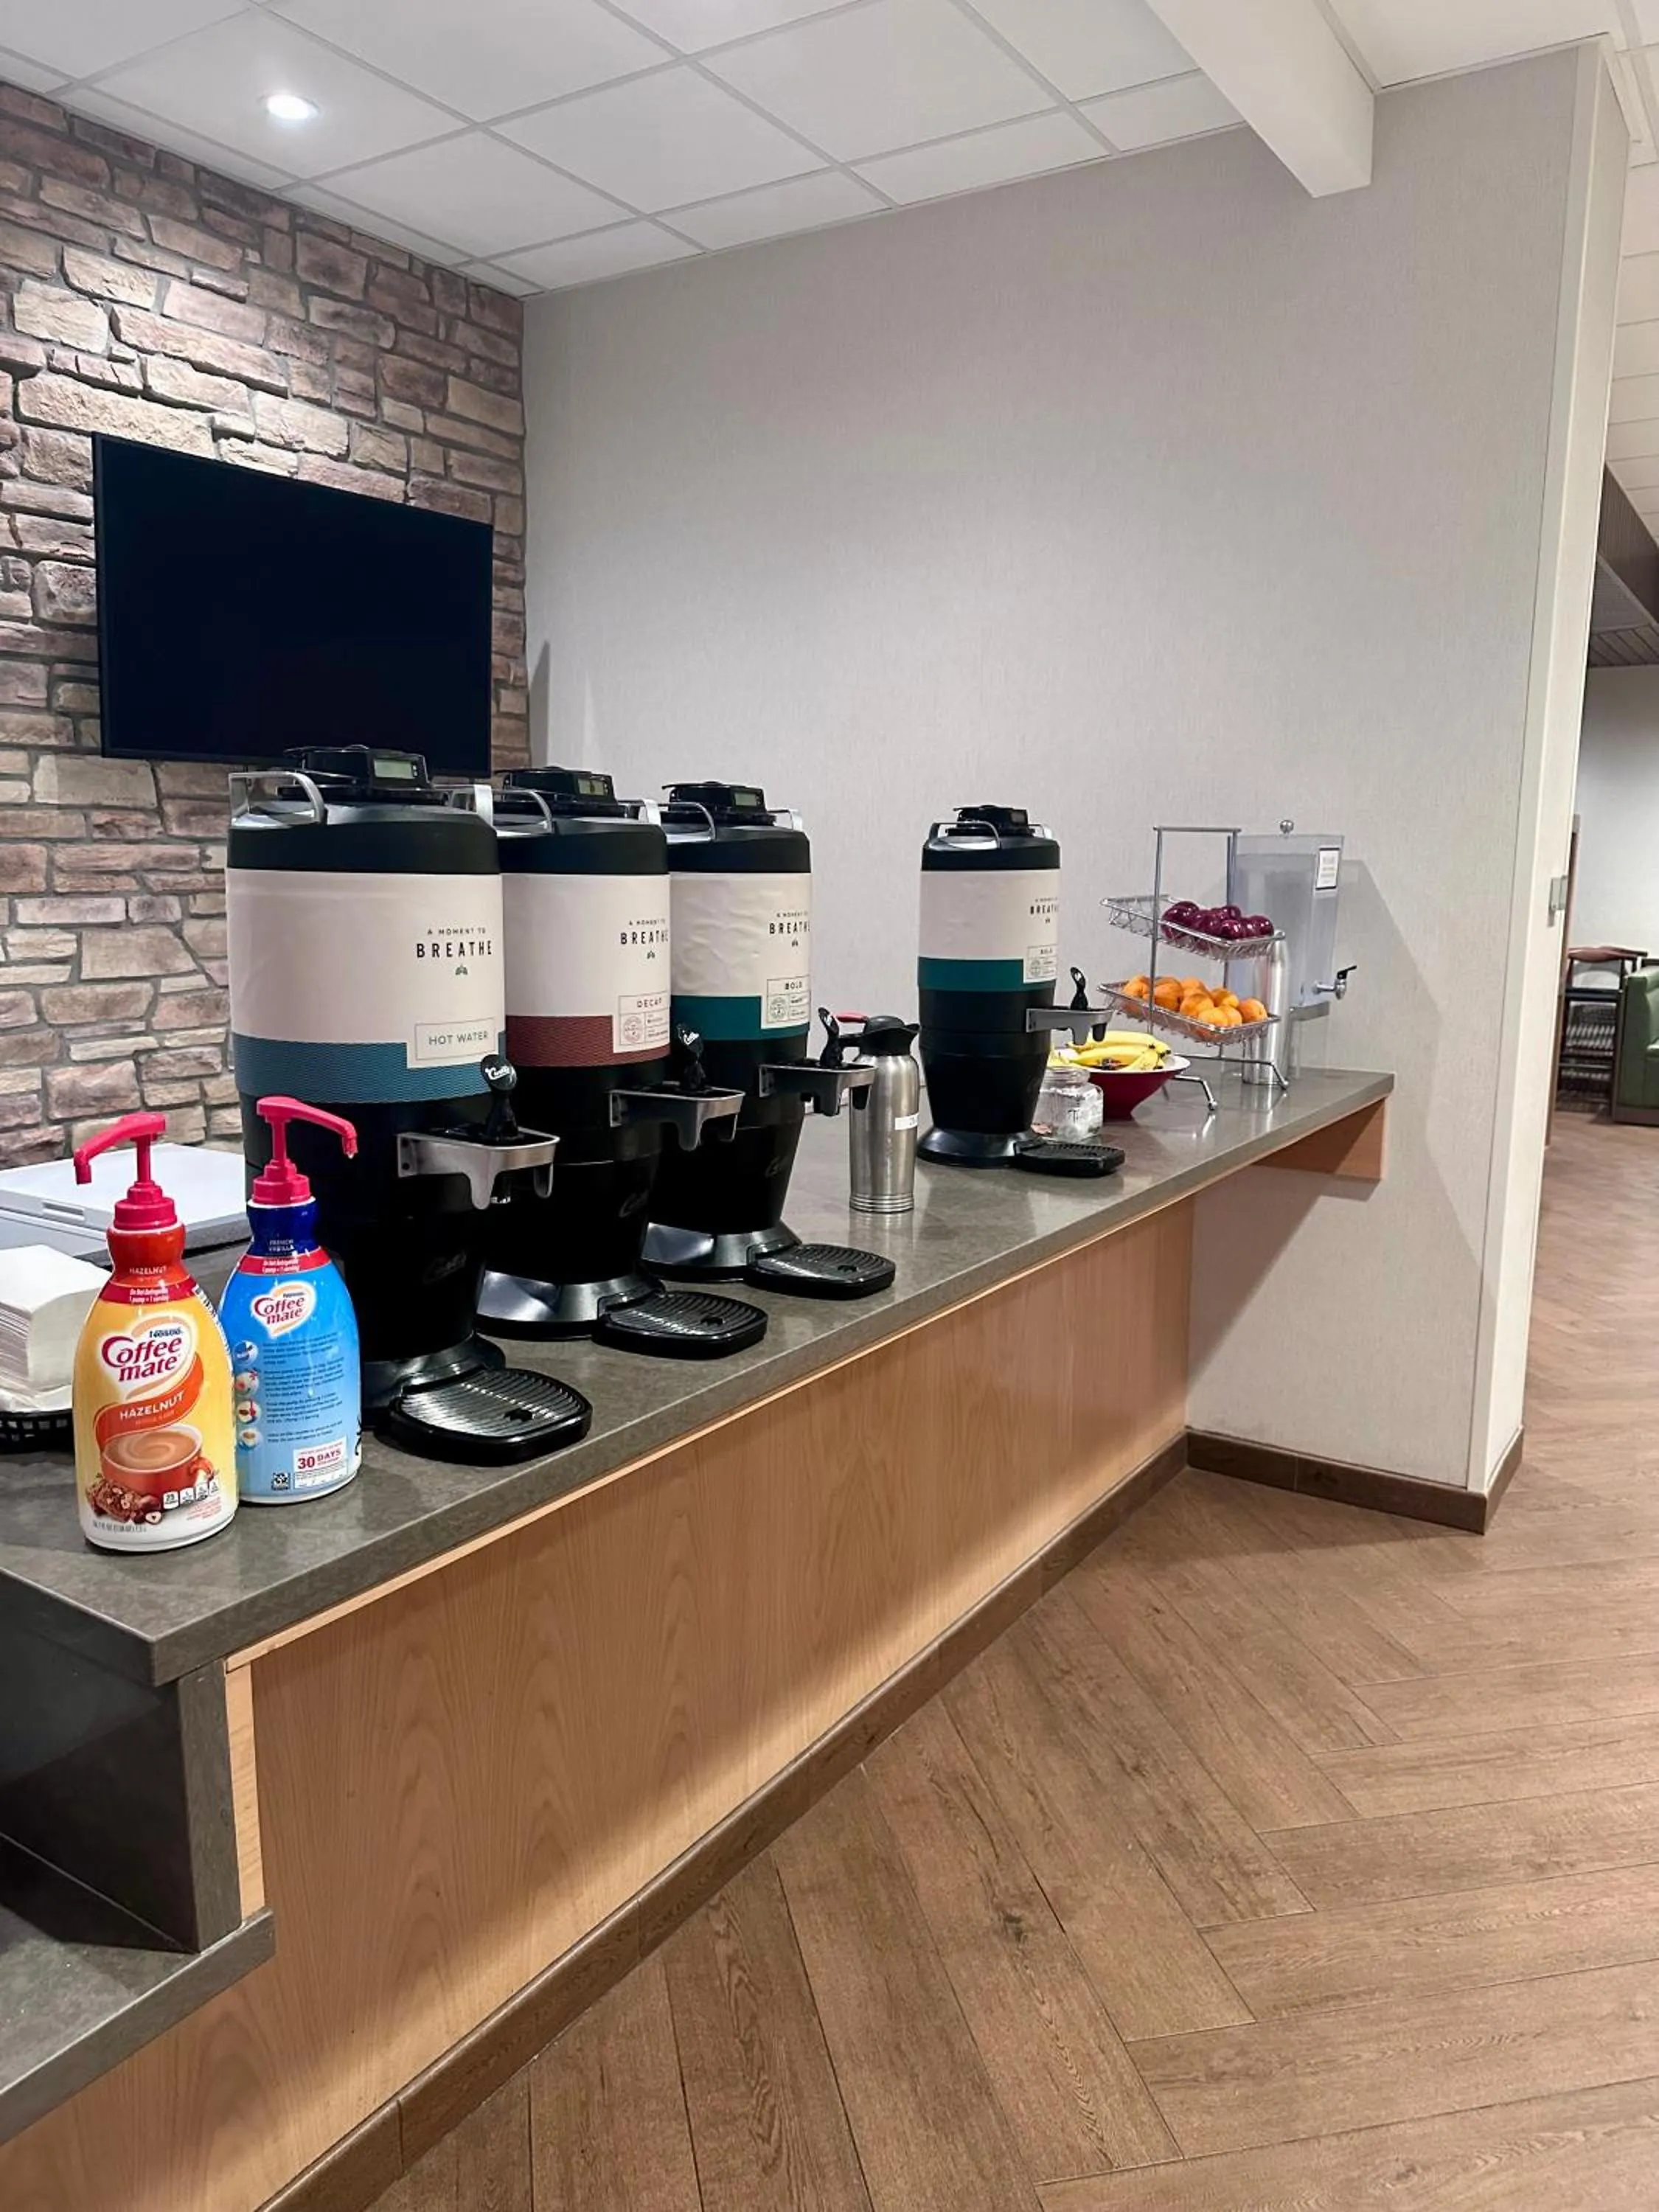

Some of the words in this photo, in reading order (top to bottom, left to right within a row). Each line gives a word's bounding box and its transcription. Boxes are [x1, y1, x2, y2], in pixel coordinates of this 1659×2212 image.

[416, 940, 492, 958] BREATHE
[428, 1034, 453, 1045] HOT
[457, 1031, 488, 1043] WATER
[129, 1265, 167, 1275] HAZELNUT
[254, 1297, 305, 1317] Coffee
[267, 1308, 303, 1325] mate
[102, 1336, 182, 1368] Coffee
[119, 1356, 178, 1382] mate
[119, 1391, 184, 1421] HAZELNUT
[298, 1456, 315, 1470] 30
[317, 1448, 341, 1462] DAYS
